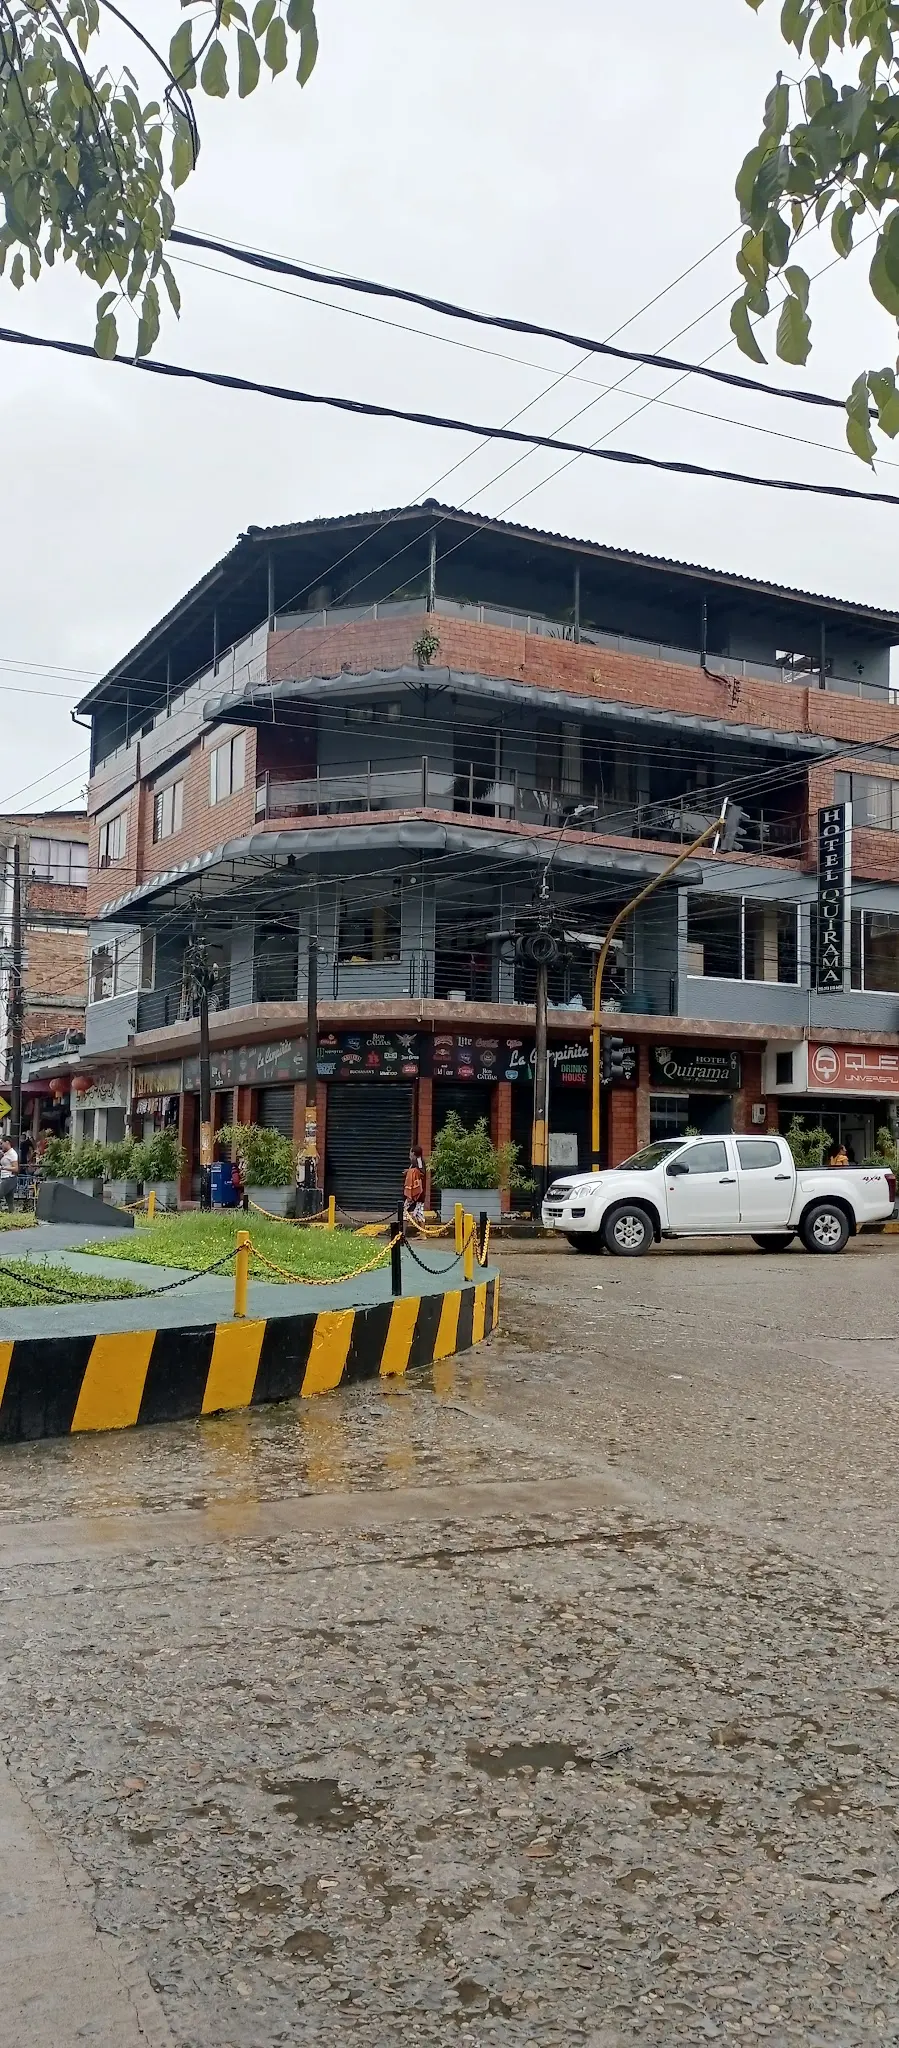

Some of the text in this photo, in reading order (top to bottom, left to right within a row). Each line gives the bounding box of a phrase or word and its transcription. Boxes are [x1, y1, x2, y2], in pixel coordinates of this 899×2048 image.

[822, 808, 841, 882] HOTEL
[821, 888, 841, 983] QUIRAMA
[458, 1036, 473, 1047] Lite
[509, 1049, 526, 1068] La
[695, 1055, 728, 1064] HOTEL
[560, 1063, 588, 1074] DRINKS
[663, 1061, 730, 1080] Quirama
[562, 1073, 587, 1082] HOUSE
